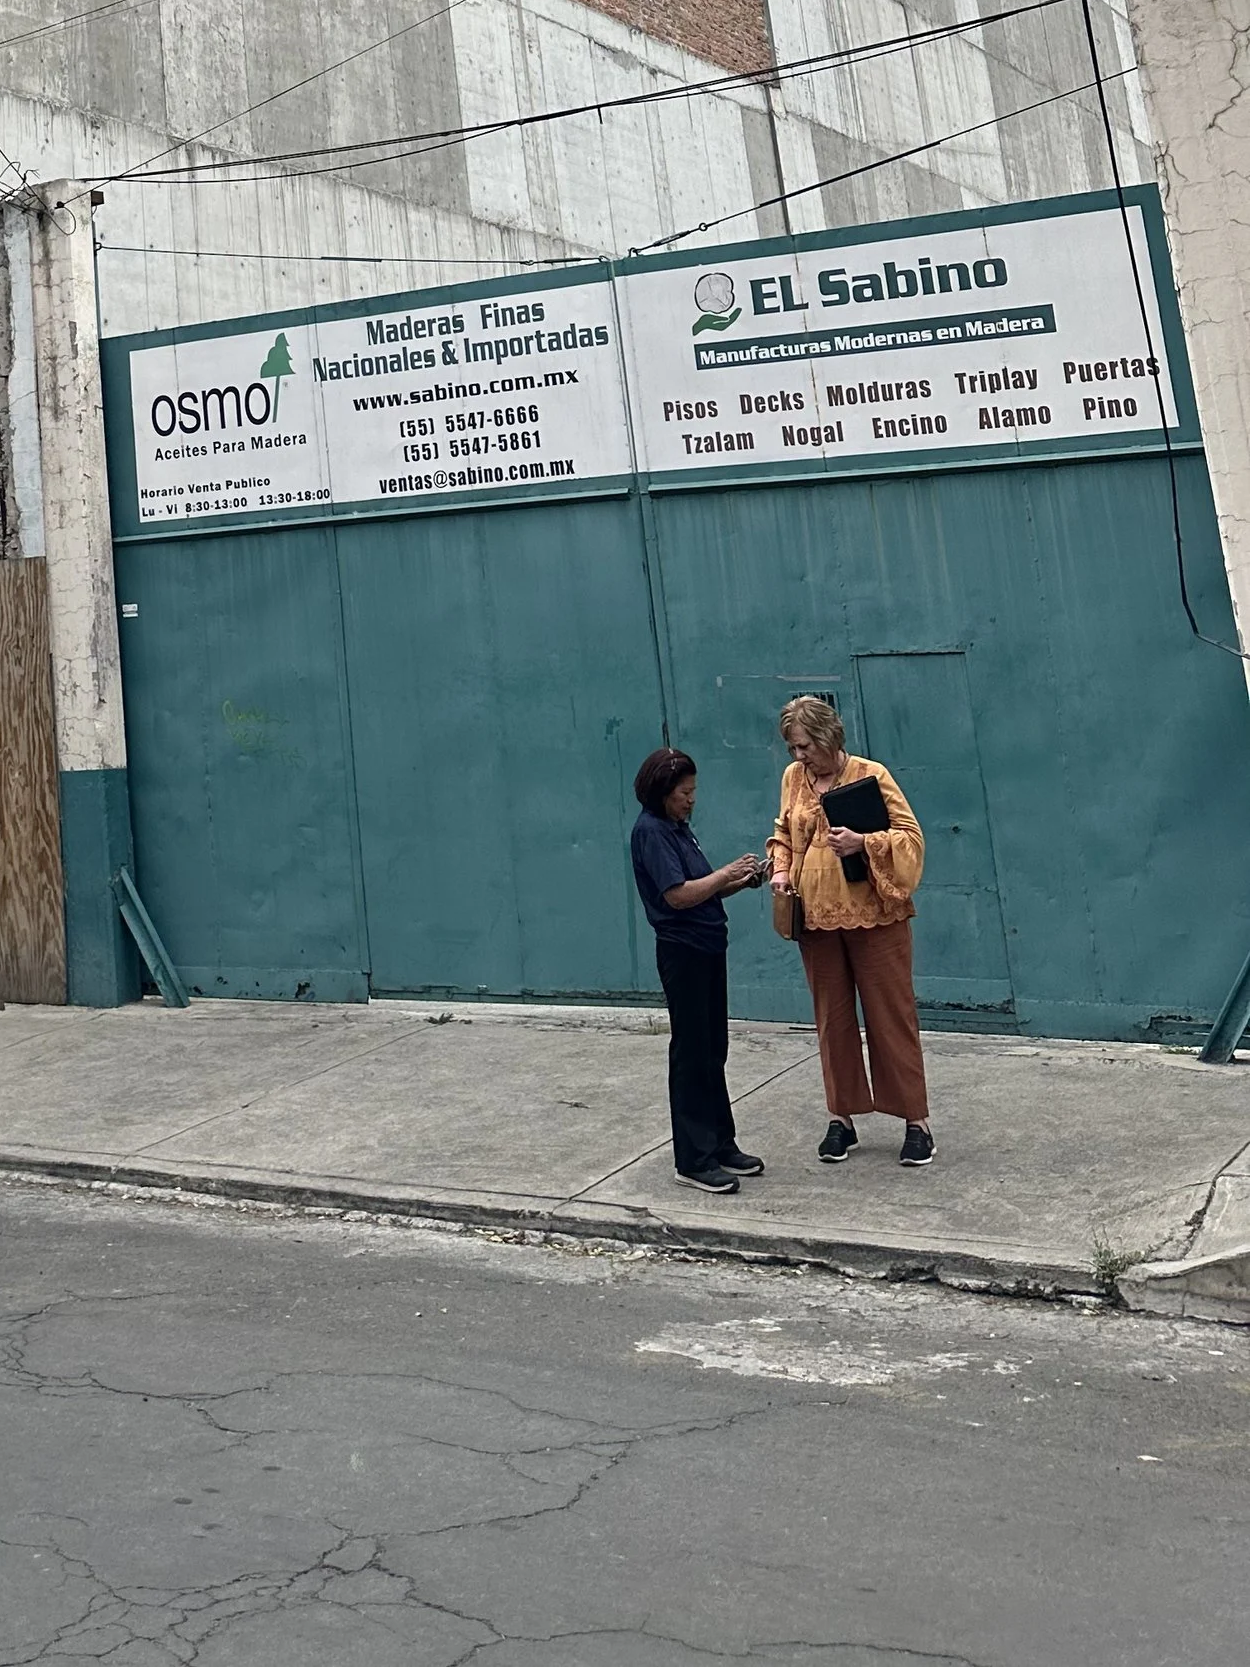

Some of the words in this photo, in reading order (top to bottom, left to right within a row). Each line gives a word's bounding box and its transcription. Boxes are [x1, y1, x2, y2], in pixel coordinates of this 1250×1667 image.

[750, 276, 808, 315] EL
[818, 258, 1007, 307] Sabino
[366, 315, 464, 345] Maderas
[480, 302, 544, 329] Finas
[699, 340, 831, 366] Manufacturas
[834, 330, 932, 351] Modernas
[937, 327, 962, 339] en
[965, 317, 1044, 336] Madera
[313, 347, 435, 382] Nacionales
[442, 341, 458, 365] &
[464, 324, 608, 365] Importadas
[152, 383, 270, 436] osmo
[353, 370, 578, 411] www.sabino.com.mx
[663, 400, 718, 421] Pisos
[740, 391, 804, 414] Decks
[827, 380, 931, 406] Molduras
[955, 366, 1037, 394] Triplay
[1063, 356, 1160, 383] Puertas
[400, 418, 434, 437] (55)
[446, 405, 538, 432] 5547-6666
[682, 432, 754, 454] Tzalam
[782, 421, 843, 446] Nogal
[872, 414, 947, 438] Encino
[979, 406, 1051, 429] Alamo
[1083, 397, 1137, 420] Pino
[155, 445, 207, 461] Aceites
[213, 442, 245, 454] Para
[251, 434, 306, 449] Madera
[404, 443, 438, 462] (55)
[450, 431, 540, 457] 5547-5861
[141, 486, 184, 498] Horario
[188, 482, 221, 493] Venta
[226, 478, 270, 489] Publico
[379, 460, 574, 493] ventas@sabino.com.mx
[142, 508, 155, 517] Lu
[166, 504, 178, 514] Vi
[186, 497, 247, 512] 8:30-13:00
[259, 489, 330, 505] 13:30-18:00
